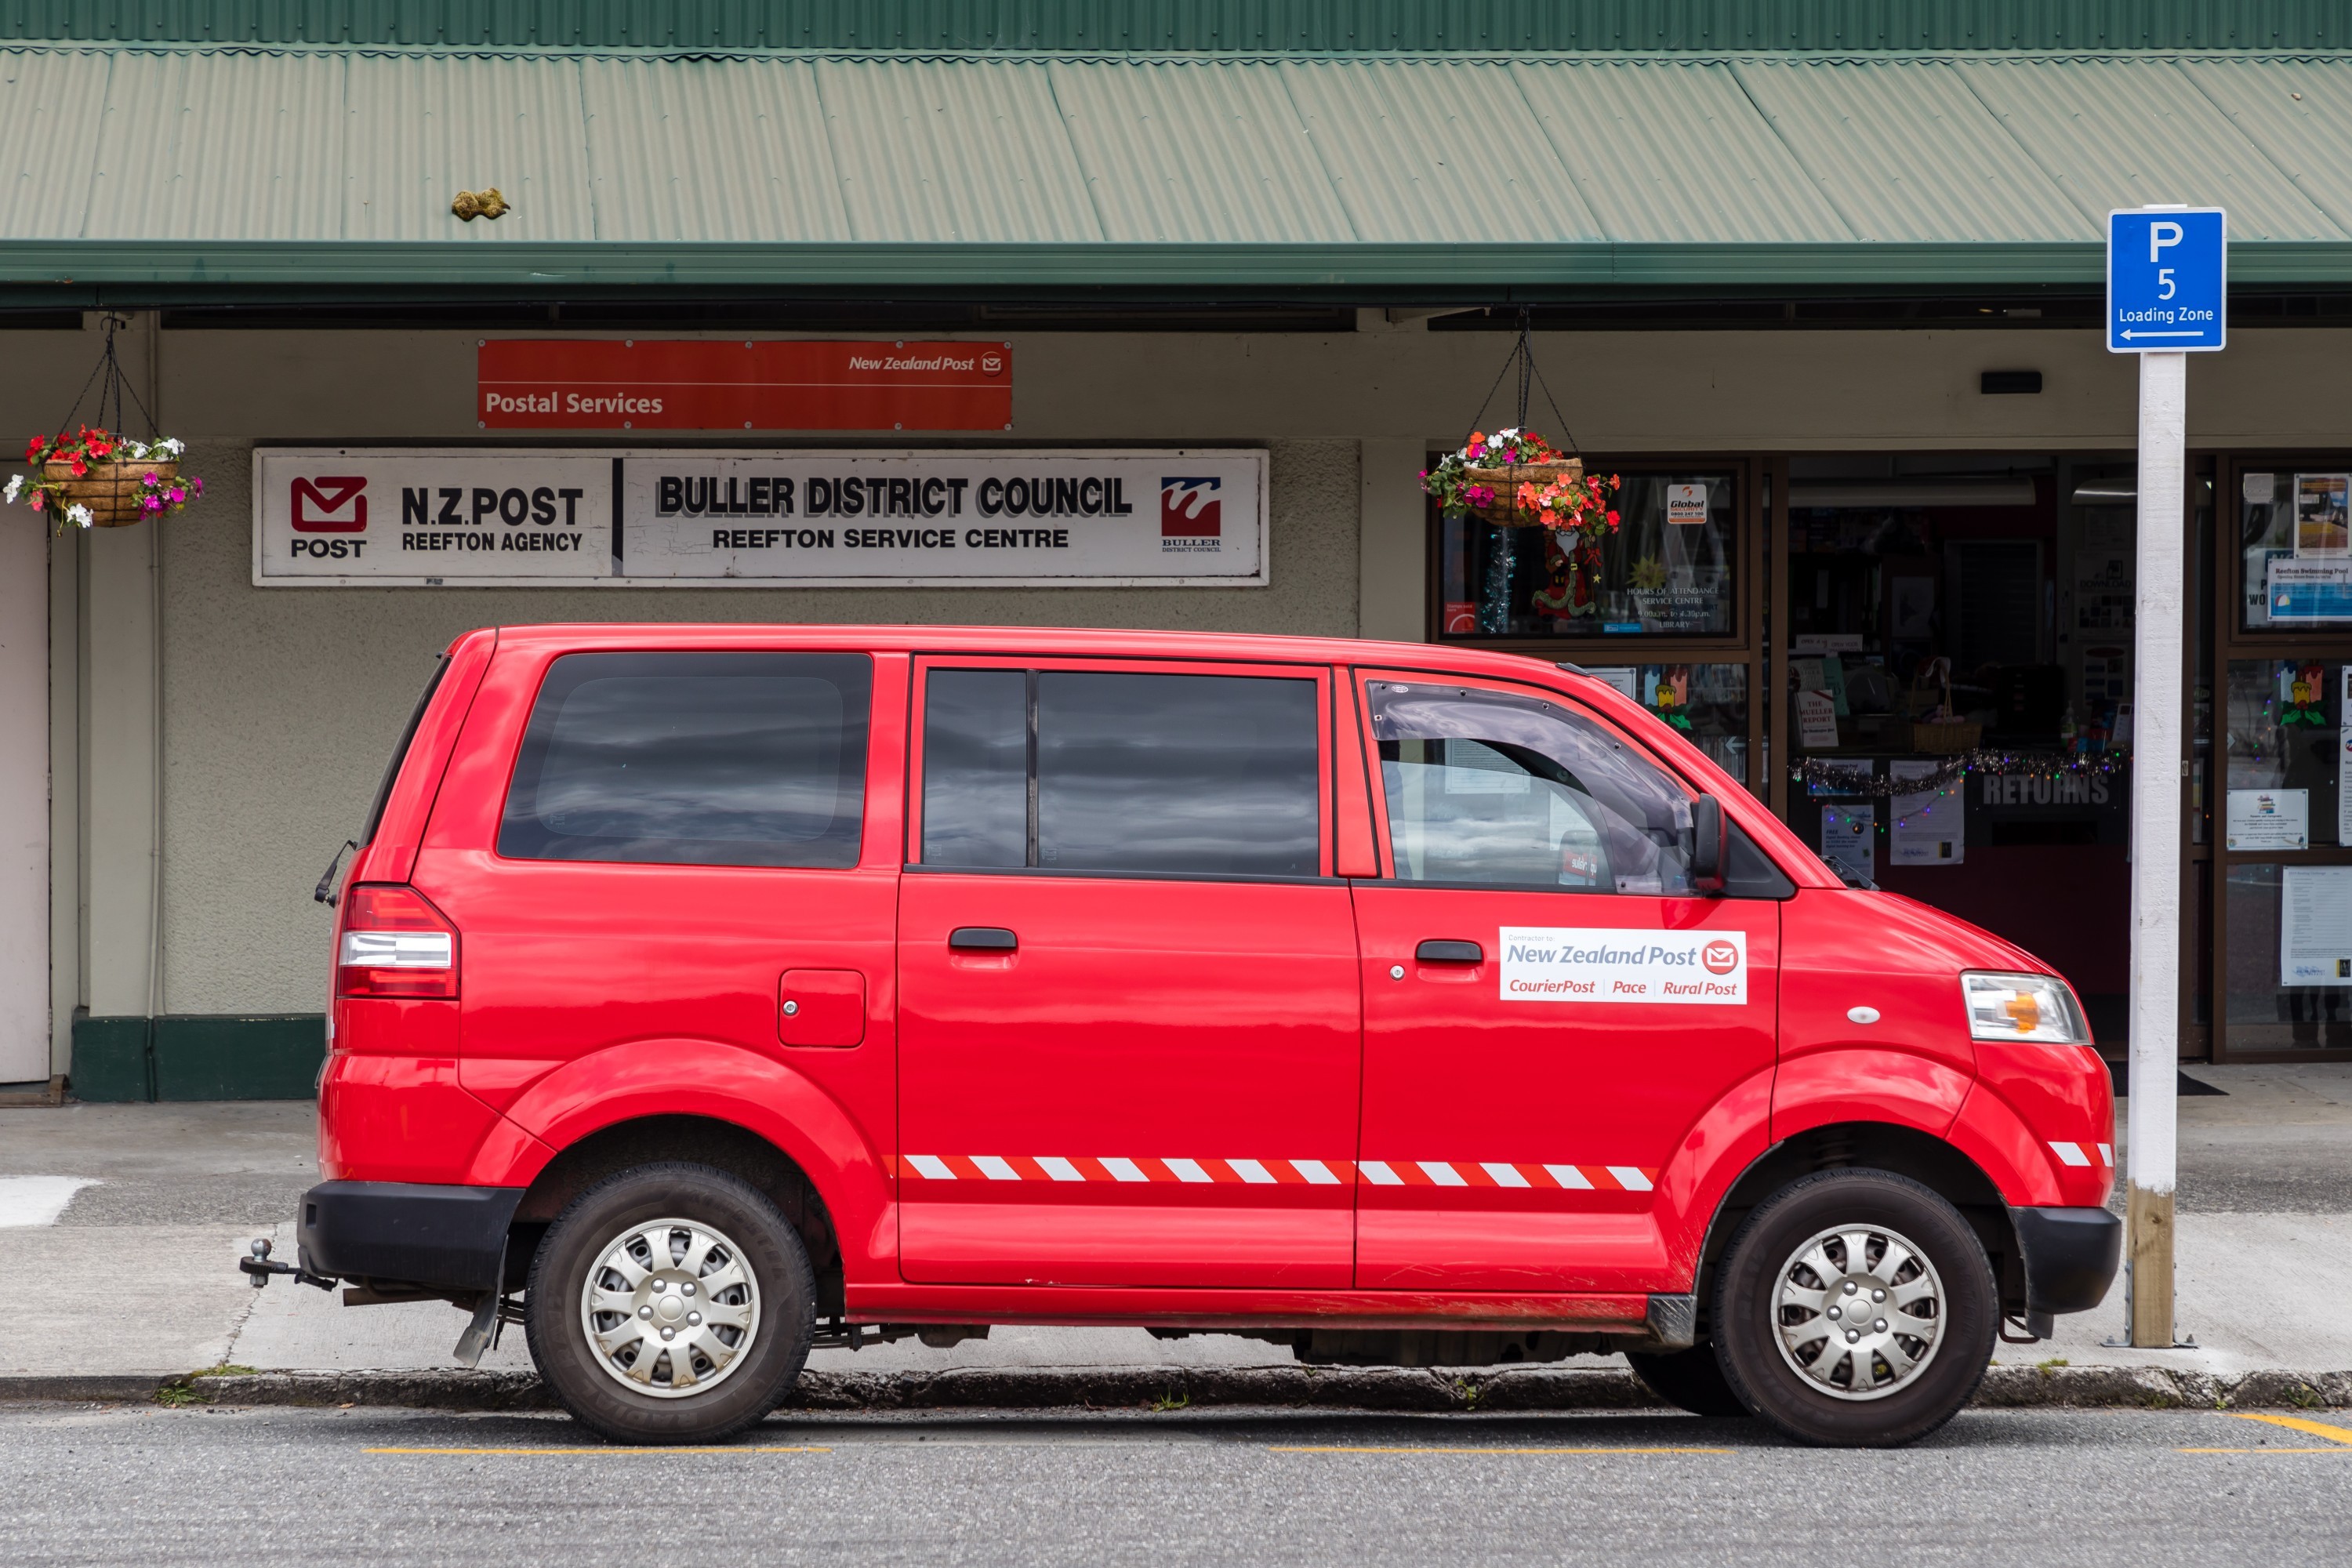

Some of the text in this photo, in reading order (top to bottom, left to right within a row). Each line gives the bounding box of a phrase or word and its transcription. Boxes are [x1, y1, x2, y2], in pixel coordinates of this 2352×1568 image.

[2151, 222, 2183, 262] P
[2158, 269, 2175, 299] 5
[2120, 307, 2213, 324] Loading Zone
[849, 356, 975, 370] New Zealand Post
[487, 392, 662, 413] Postal Services
[402, 487, 583, 526] N.Z.POST
[655, 476, 1133, 517] BULLER DISTRICT COUNCIL
[292, 539, 367, 558] POST
[403, 532, 582, 551] REEFTON AGENCY
[713, 529, 1068, 548] REEFTON SERVICE CENTRE
[1627, 586, 1719, 596] HOURS OF ATTENDANCE
[1983, 774, 2109, 805] RETURNS
[1507, 944, 1697, 967] New Zealand Post
[1509, 978, 1737, 996] CourierPost Pace Rural Post
